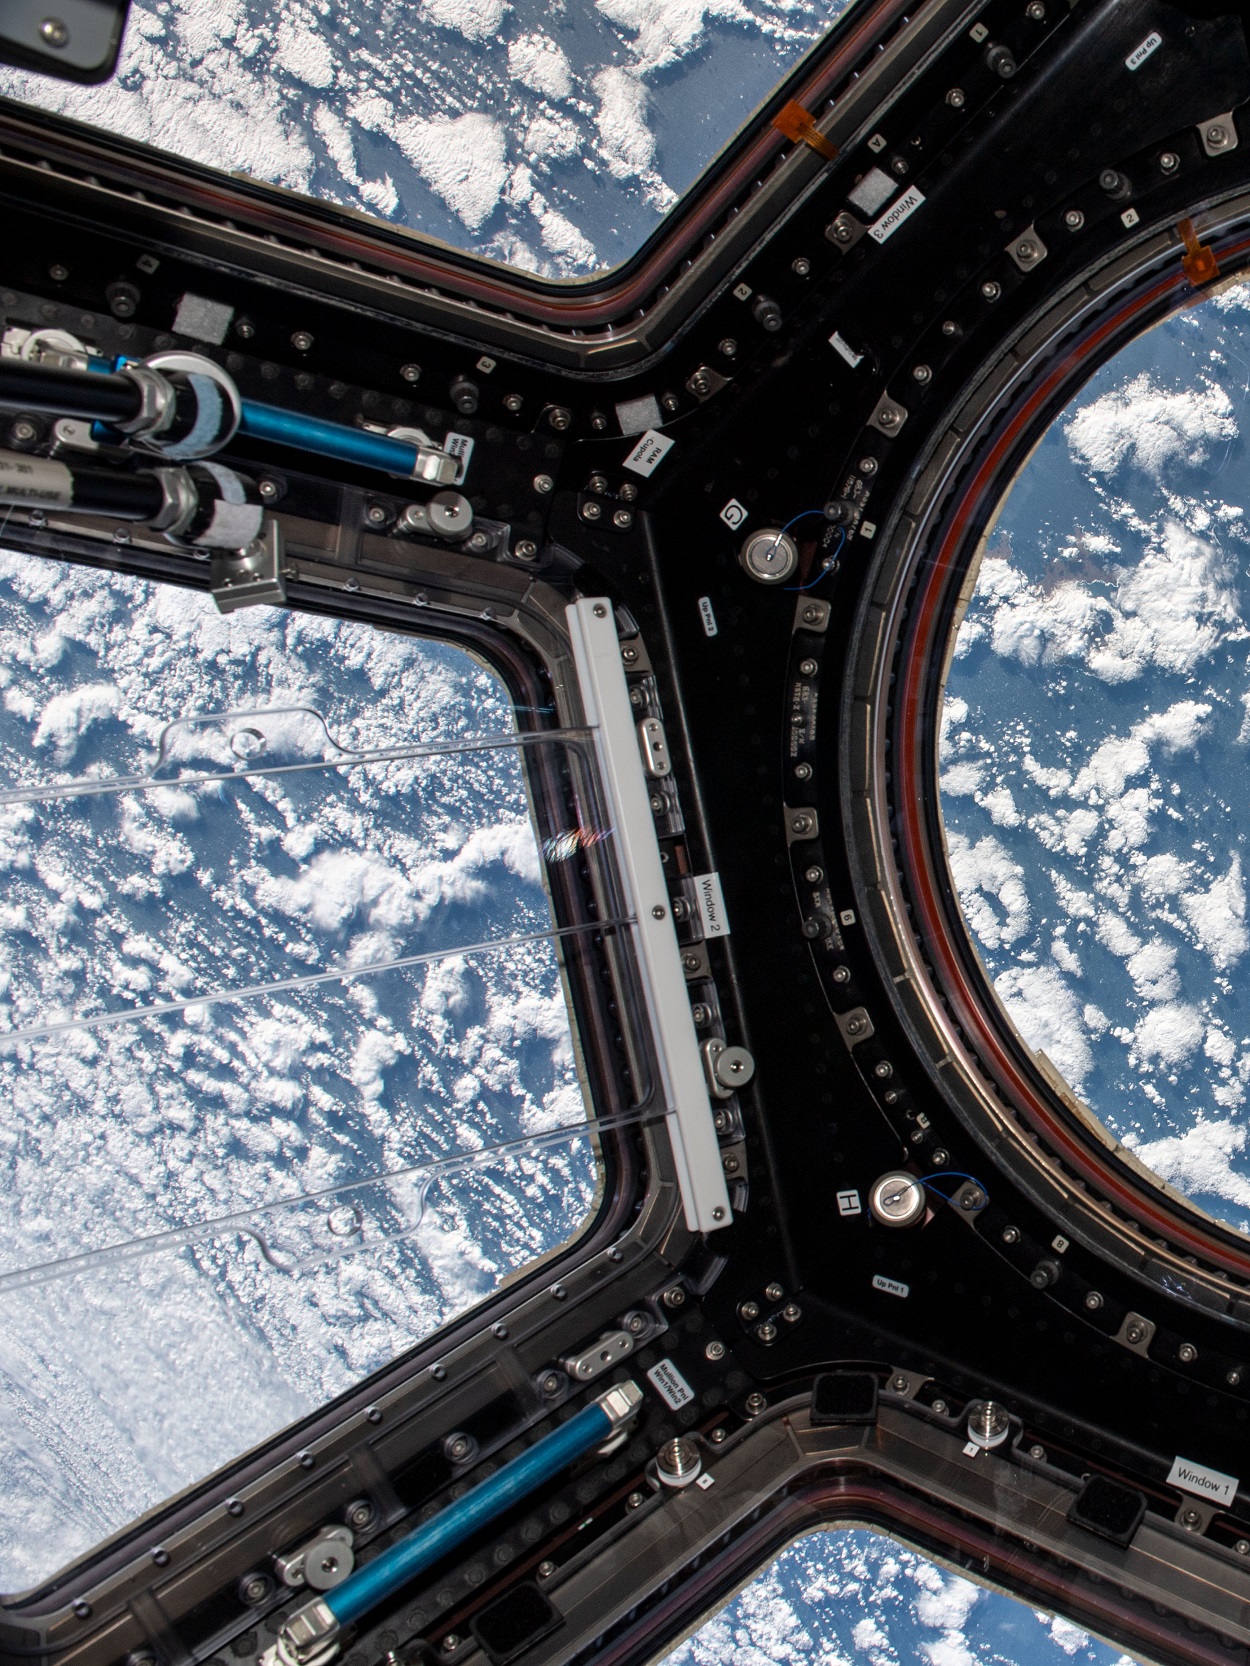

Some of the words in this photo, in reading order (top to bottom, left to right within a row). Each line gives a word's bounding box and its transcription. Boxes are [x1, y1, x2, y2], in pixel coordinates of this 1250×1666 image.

[1145, 38, 1157, 49] Up
[872, 138, 880, 147] A
[881, 195, 918, 231] Window
[1126, 213, 1135, 223] 2
[873, 229, 884, 239] 3
[481, 361, 491, 369] 3
[633, 438, 654, 462] Cupola
[646, 447, 662, 464] RAM
[724, 505, 743, 525] G
[702, 601, 709, 612] Up
[702, 879, 716, 921] Window
[710, 924, 721, 932] 2
[839, 1194, 859, 1211] H
[1057, 1239, 1065, 1249] 8
[877, 1279, 887, 1288] Up
[887, 1282, 899, 1292] Pnl
[654, 1369, 682, 1405] Win1/Win2
[660, 1363, 679, 1389] Mullion
[677, 1387, 689, 1400] Pnl
[1178, 1466, 1221, 1492] Window
[1224, 1485, 1230, 1495] 1
